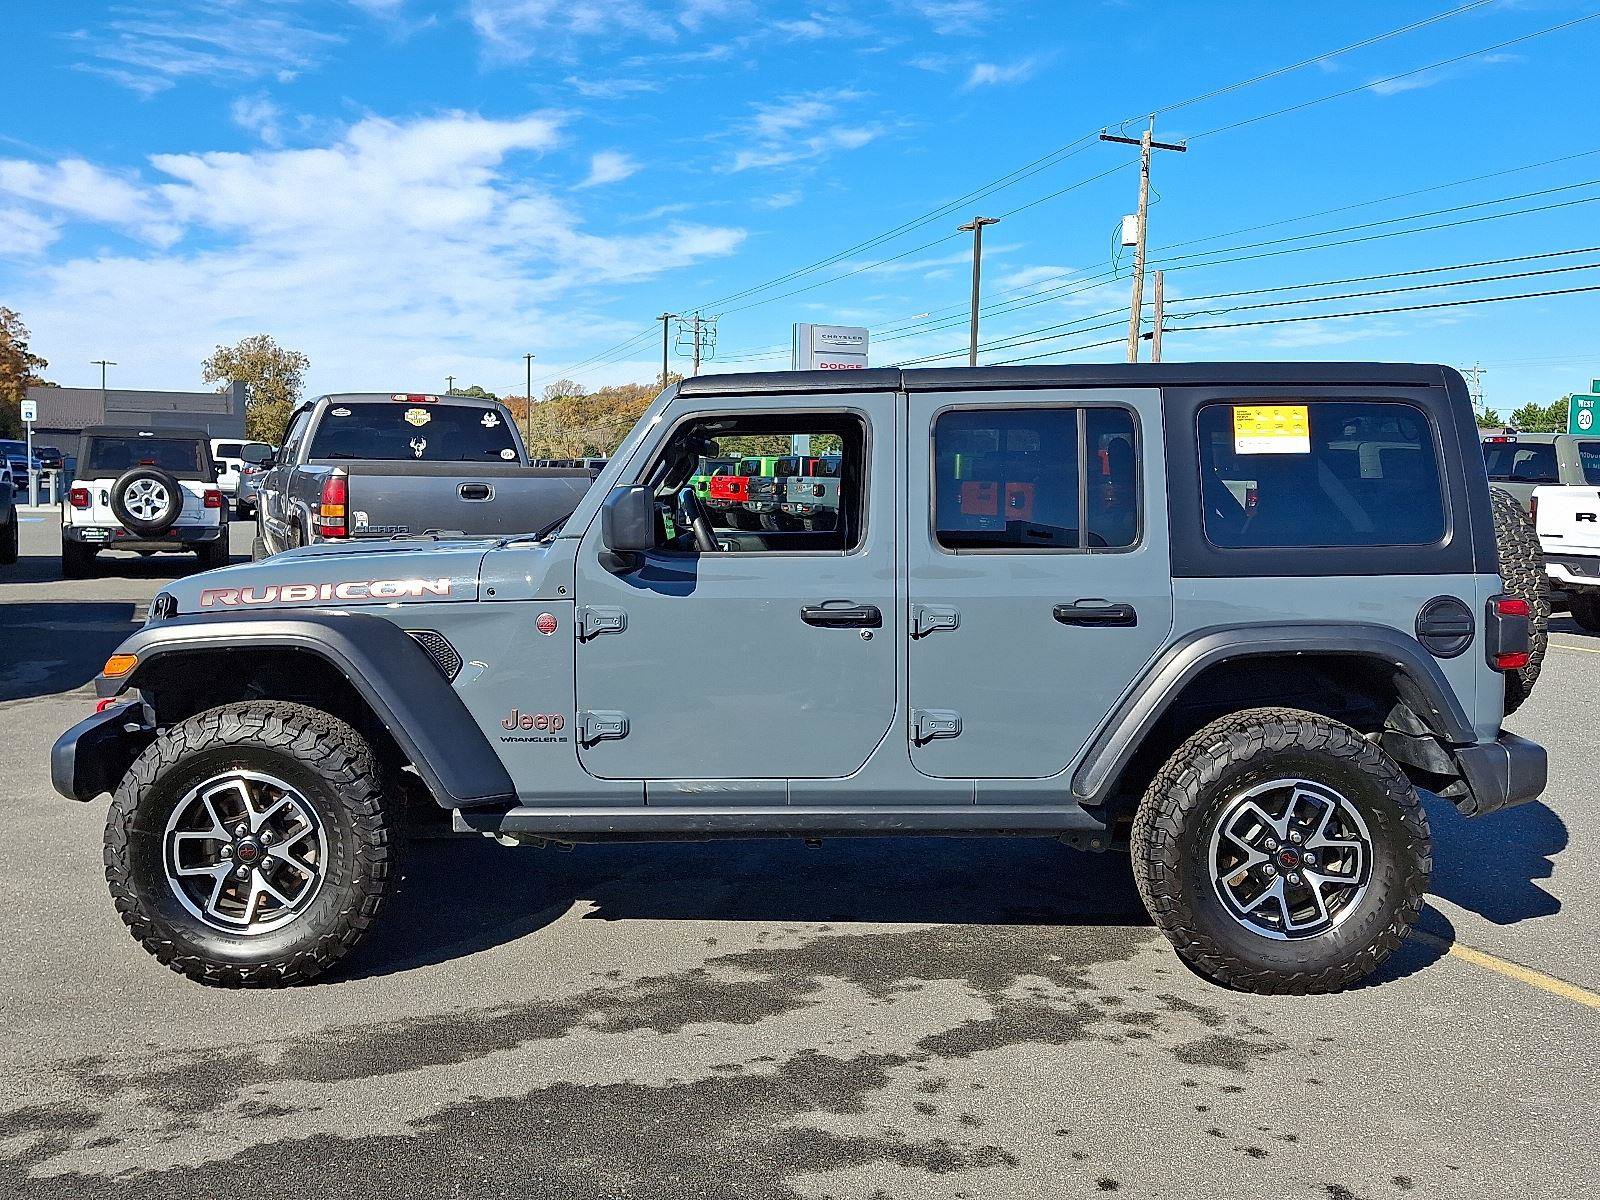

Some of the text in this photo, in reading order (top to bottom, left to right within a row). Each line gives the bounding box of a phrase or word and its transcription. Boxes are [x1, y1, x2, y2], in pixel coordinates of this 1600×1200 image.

[1577, 399, 1595, 408] WEST
[1579, 414, 1591, 425] 20
[200, 577, 452, 607] RUBICON
[501, 708, 565, 735] Jeep
